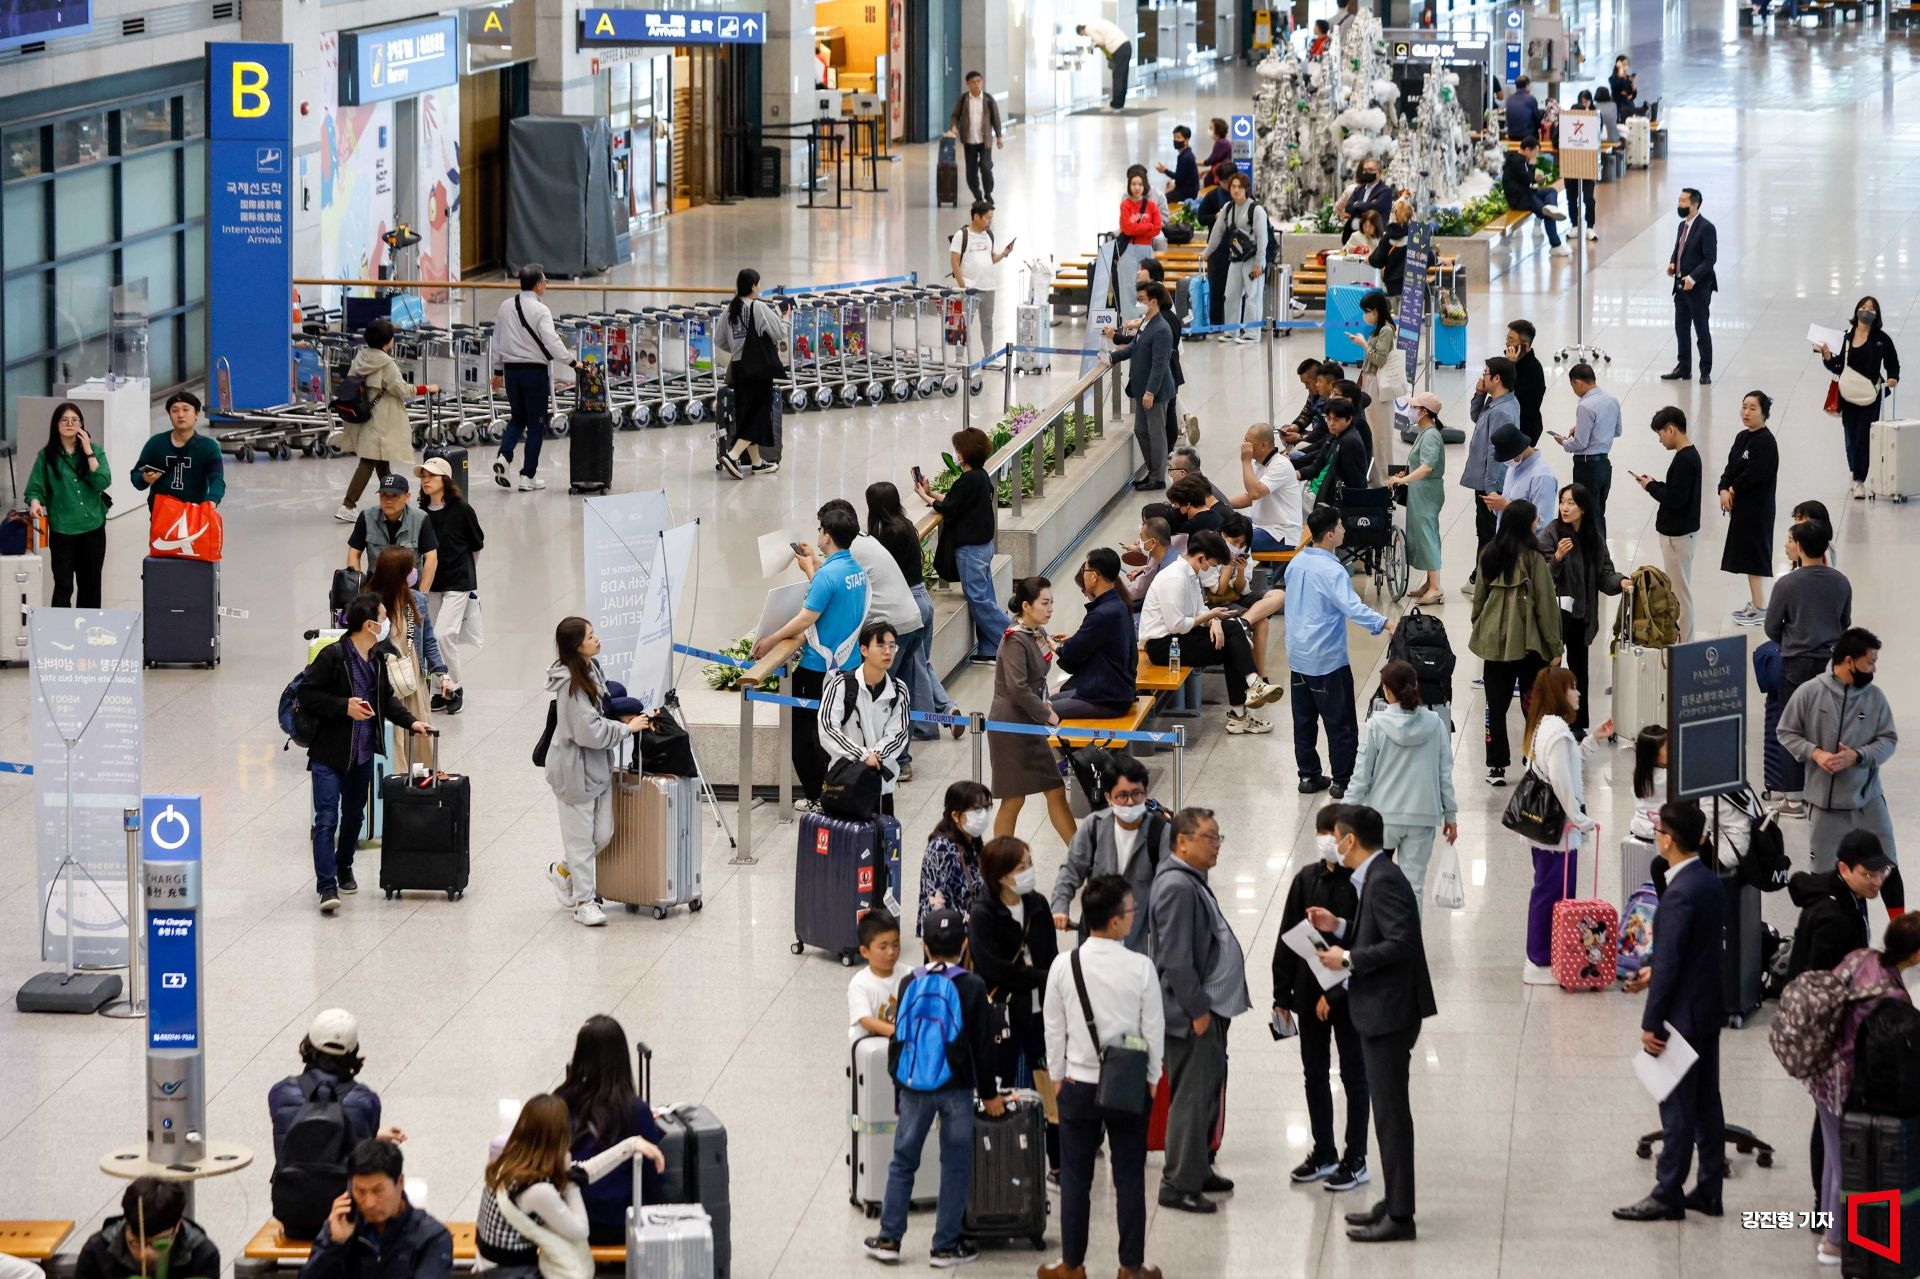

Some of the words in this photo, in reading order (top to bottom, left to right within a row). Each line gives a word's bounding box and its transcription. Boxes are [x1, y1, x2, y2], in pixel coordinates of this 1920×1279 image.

[484, 11, 503, 32] A
[595, 13, 616, 36] A
[232, 61, 271, 118] B
[226, 182, 282, 195] 국제선도착
[222, 225, 282, 234] International
[247, 235, 282, 244] Arrivals
[1692, 665, 1730, 680] PARADISE
[924, 713, 955, 723] SECURITY
